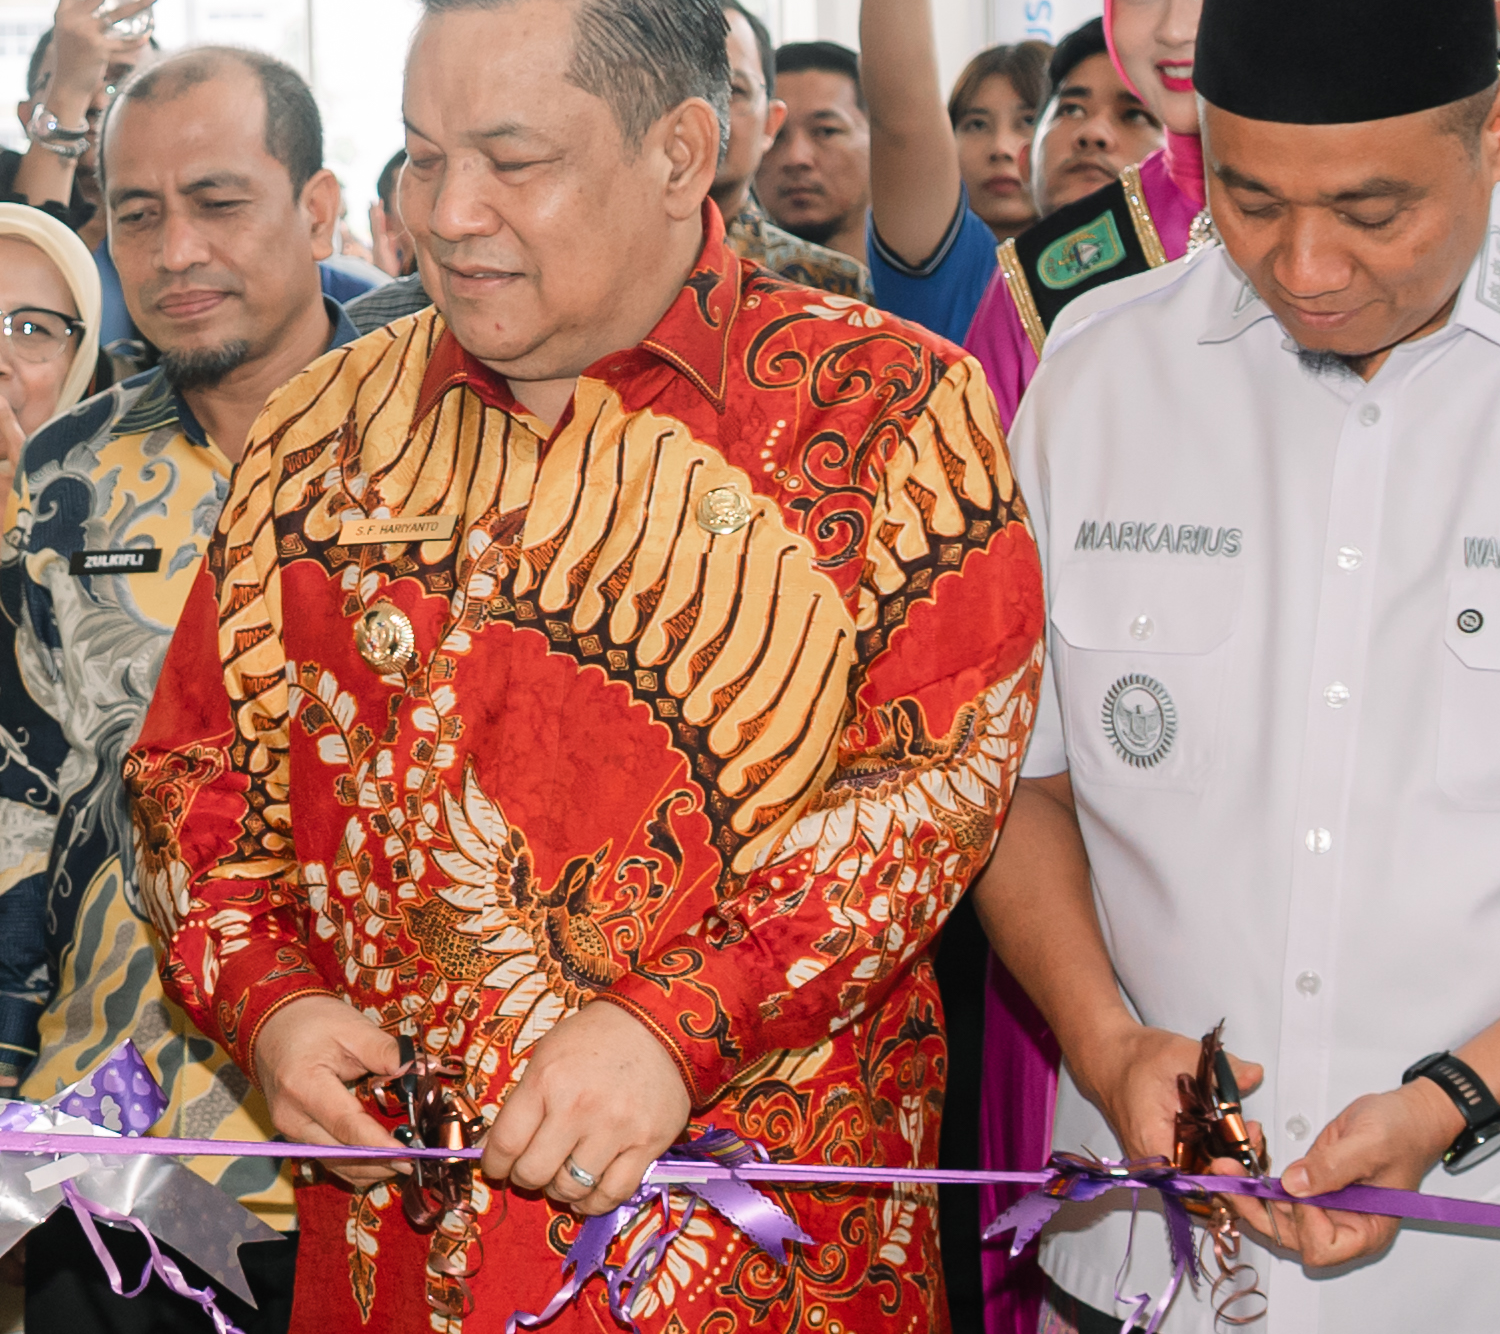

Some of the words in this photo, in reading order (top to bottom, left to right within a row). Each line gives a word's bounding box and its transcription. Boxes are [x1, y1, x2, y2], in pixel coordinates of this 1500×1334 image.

[378, 521, 439, 535] HARIYANTO
[1073, 520, 1243, 558] MARKARIUS
[83, 552, 144, 568] ZULKIFLI
